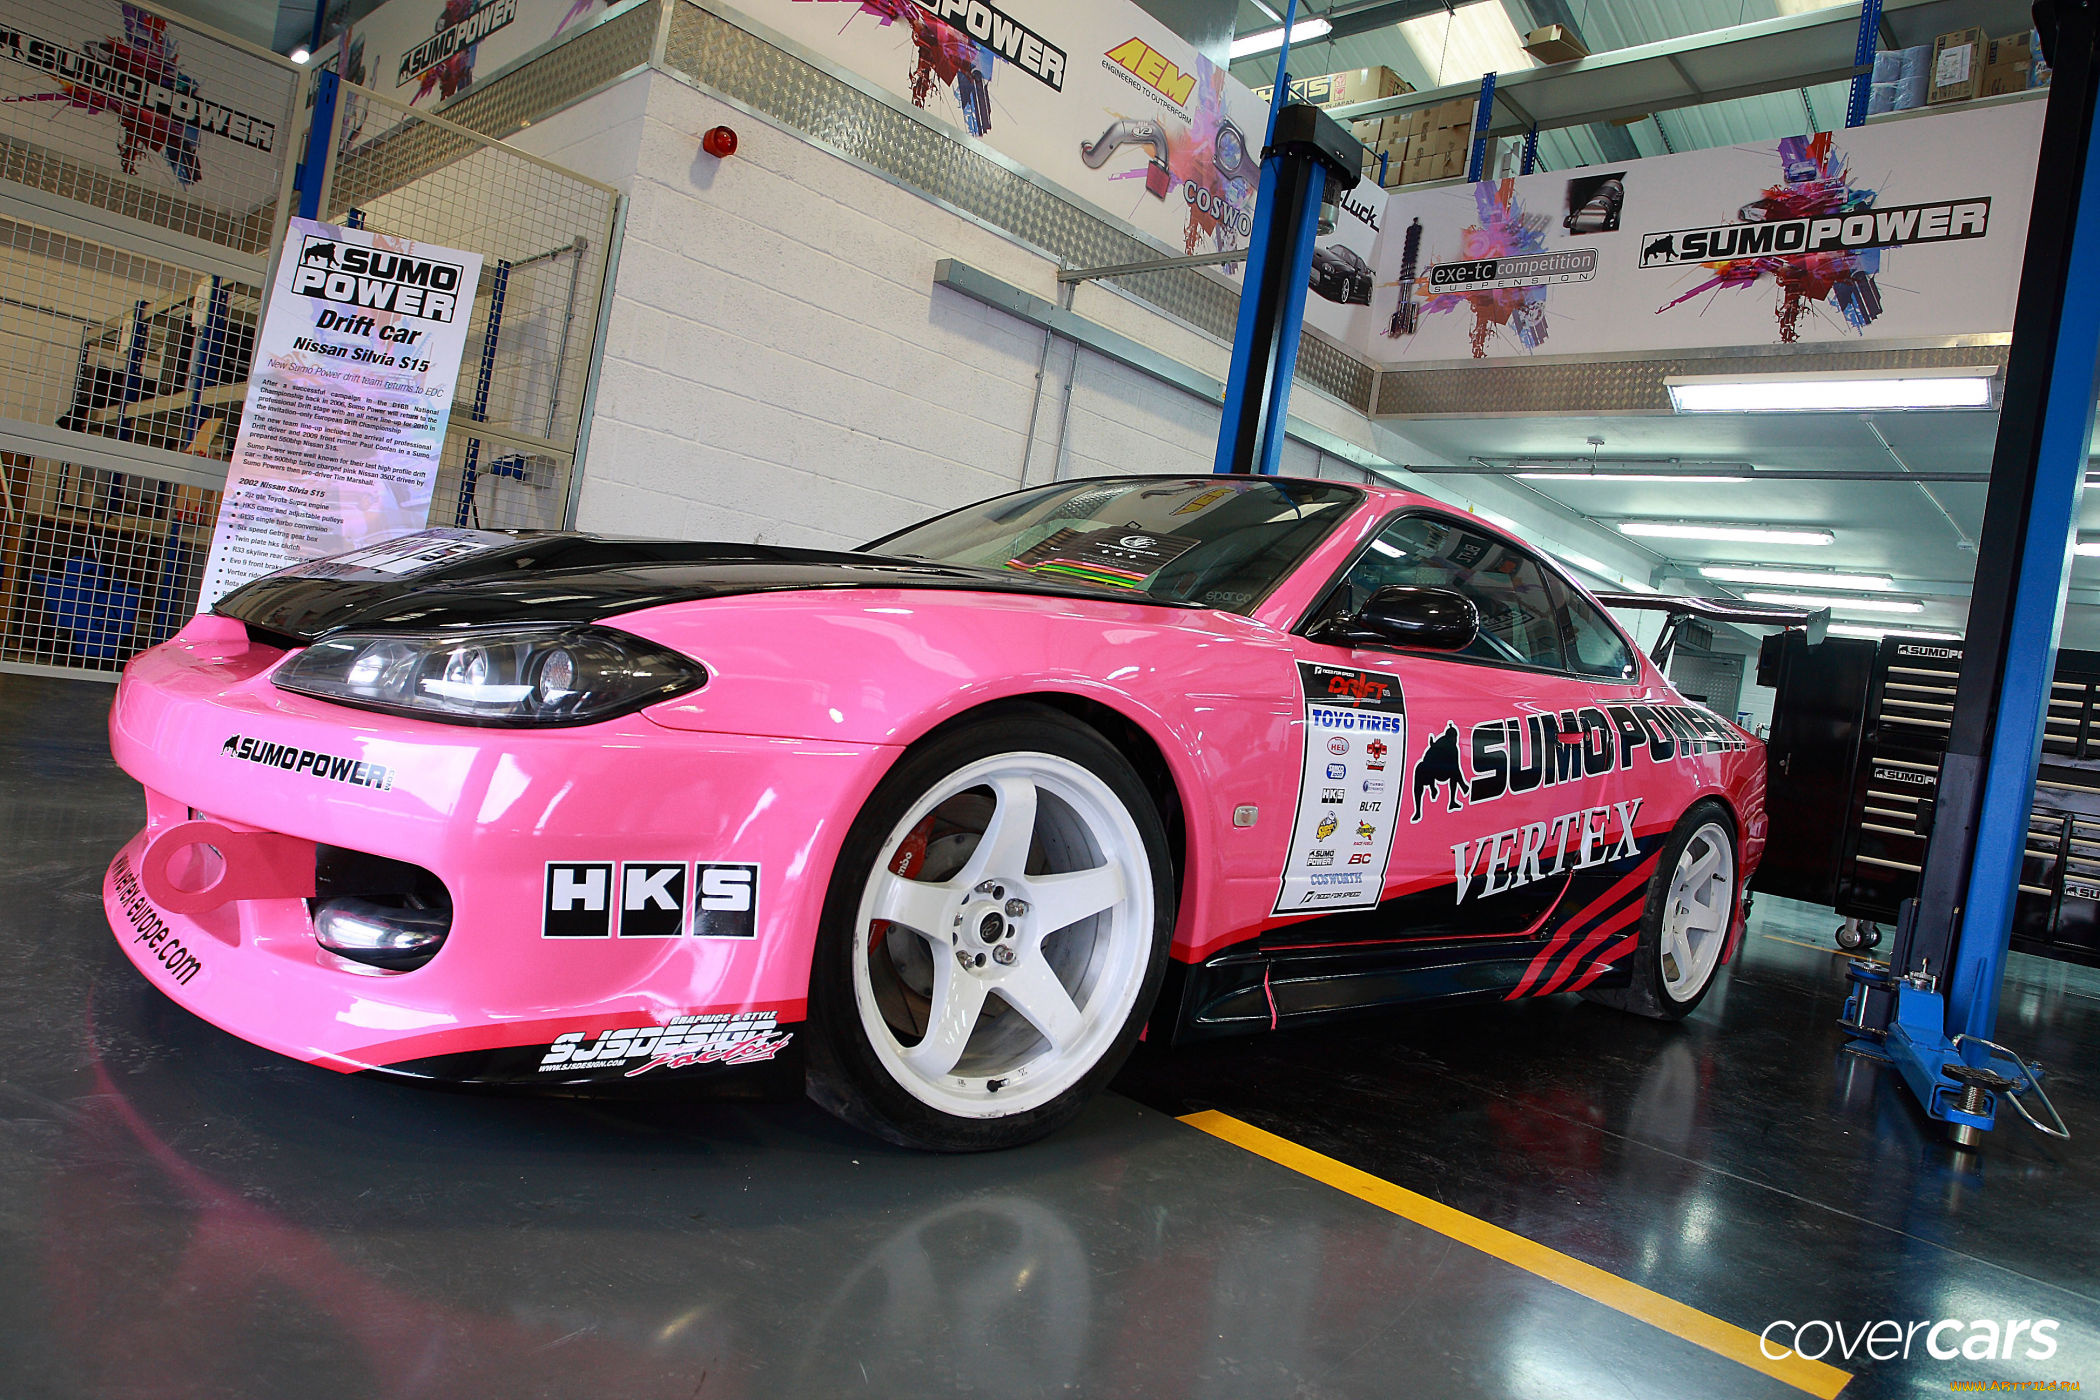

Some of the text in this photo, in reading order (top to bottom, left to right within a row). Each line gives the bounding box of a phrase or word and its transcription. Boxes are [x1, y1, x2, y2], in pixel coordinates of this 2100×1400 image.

[1104, 37, 1197, 107] AEM
[1101, 60, 1192, 125] ENGINEERED TO OUTPERFORM
[340, 248, 457, 291] SUMO
[1433, 272, 1589, 293] SUSPENSION
[1434, 253, 1592, 284] exe-tc competition
[293, 267, 455, 322] POWER
[315, 308, 422, 345] Drift car
[292, 336, 430, 372] Nissan Silvia S15
[268, 358, 443, 397] New Sumo Power drift team returns to EDC
[238, 477, 325, 497] 2002 Nissan Silvia S15
[308, 502, 329, 511] engine
[245, 549, 268, 558] skyline
[250, 538, 266, 546] plate
[1327, 672, 1388, 708] DRIFT
[1313, 709, 1400, 734] TOYO TIRES
[1322, 788, 1345, 800] HKS
[1348, 853, 1371, 865] BC
[1450, 797, 1643, 905] VERTEX
[551, 868, 752, 911] HKS
[1310, 872, 1363, 886] COSWORTH
[670, 1011, 778, 1025] GRAPHICS & STYLE
[538, 1059, 626, 1073] WWW.SJSDESIGN.COM
